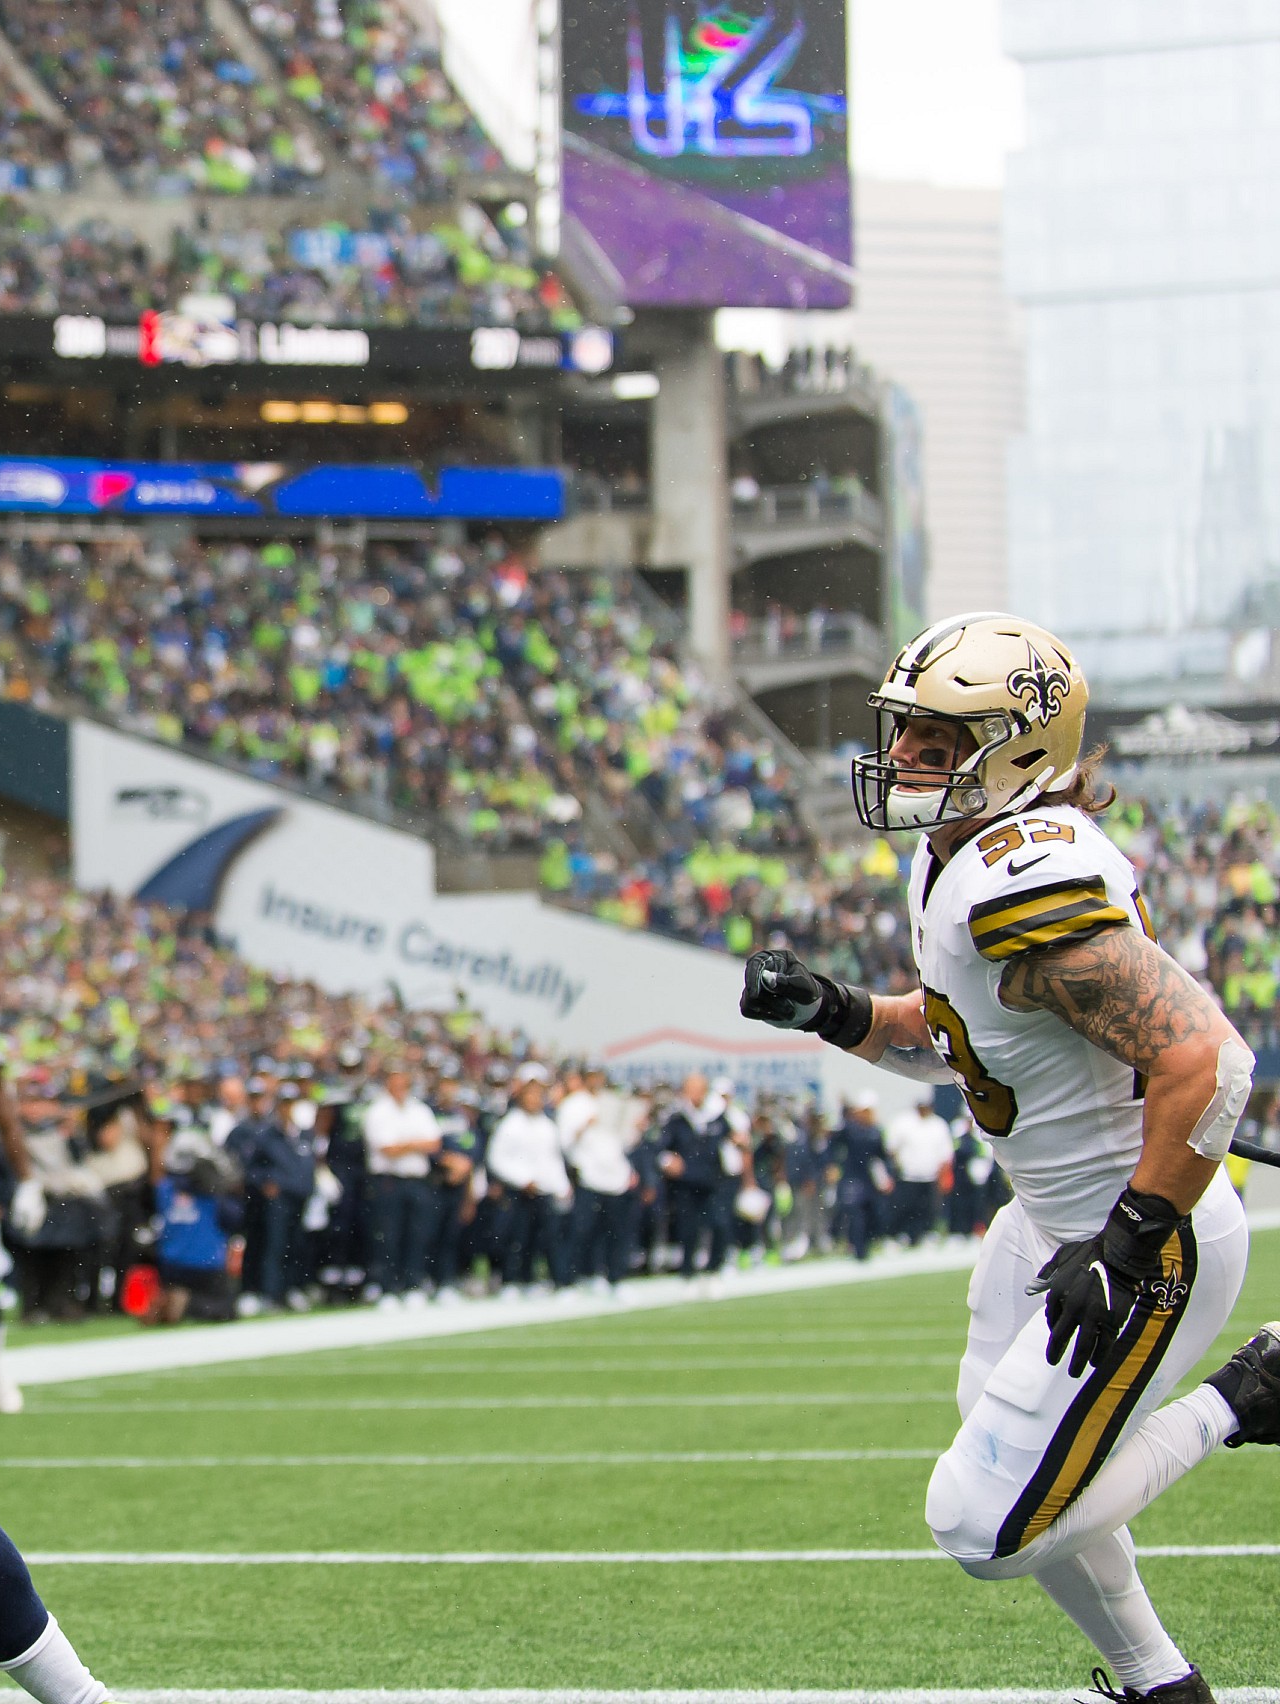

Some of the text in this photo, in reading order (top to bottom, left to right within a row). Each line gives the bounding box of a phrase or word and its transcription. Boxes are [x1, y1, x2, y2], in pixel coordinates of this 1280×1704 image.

[975, 818, 1075, 868] 53
[258, 880, 583, 1017] Insure Carefully
